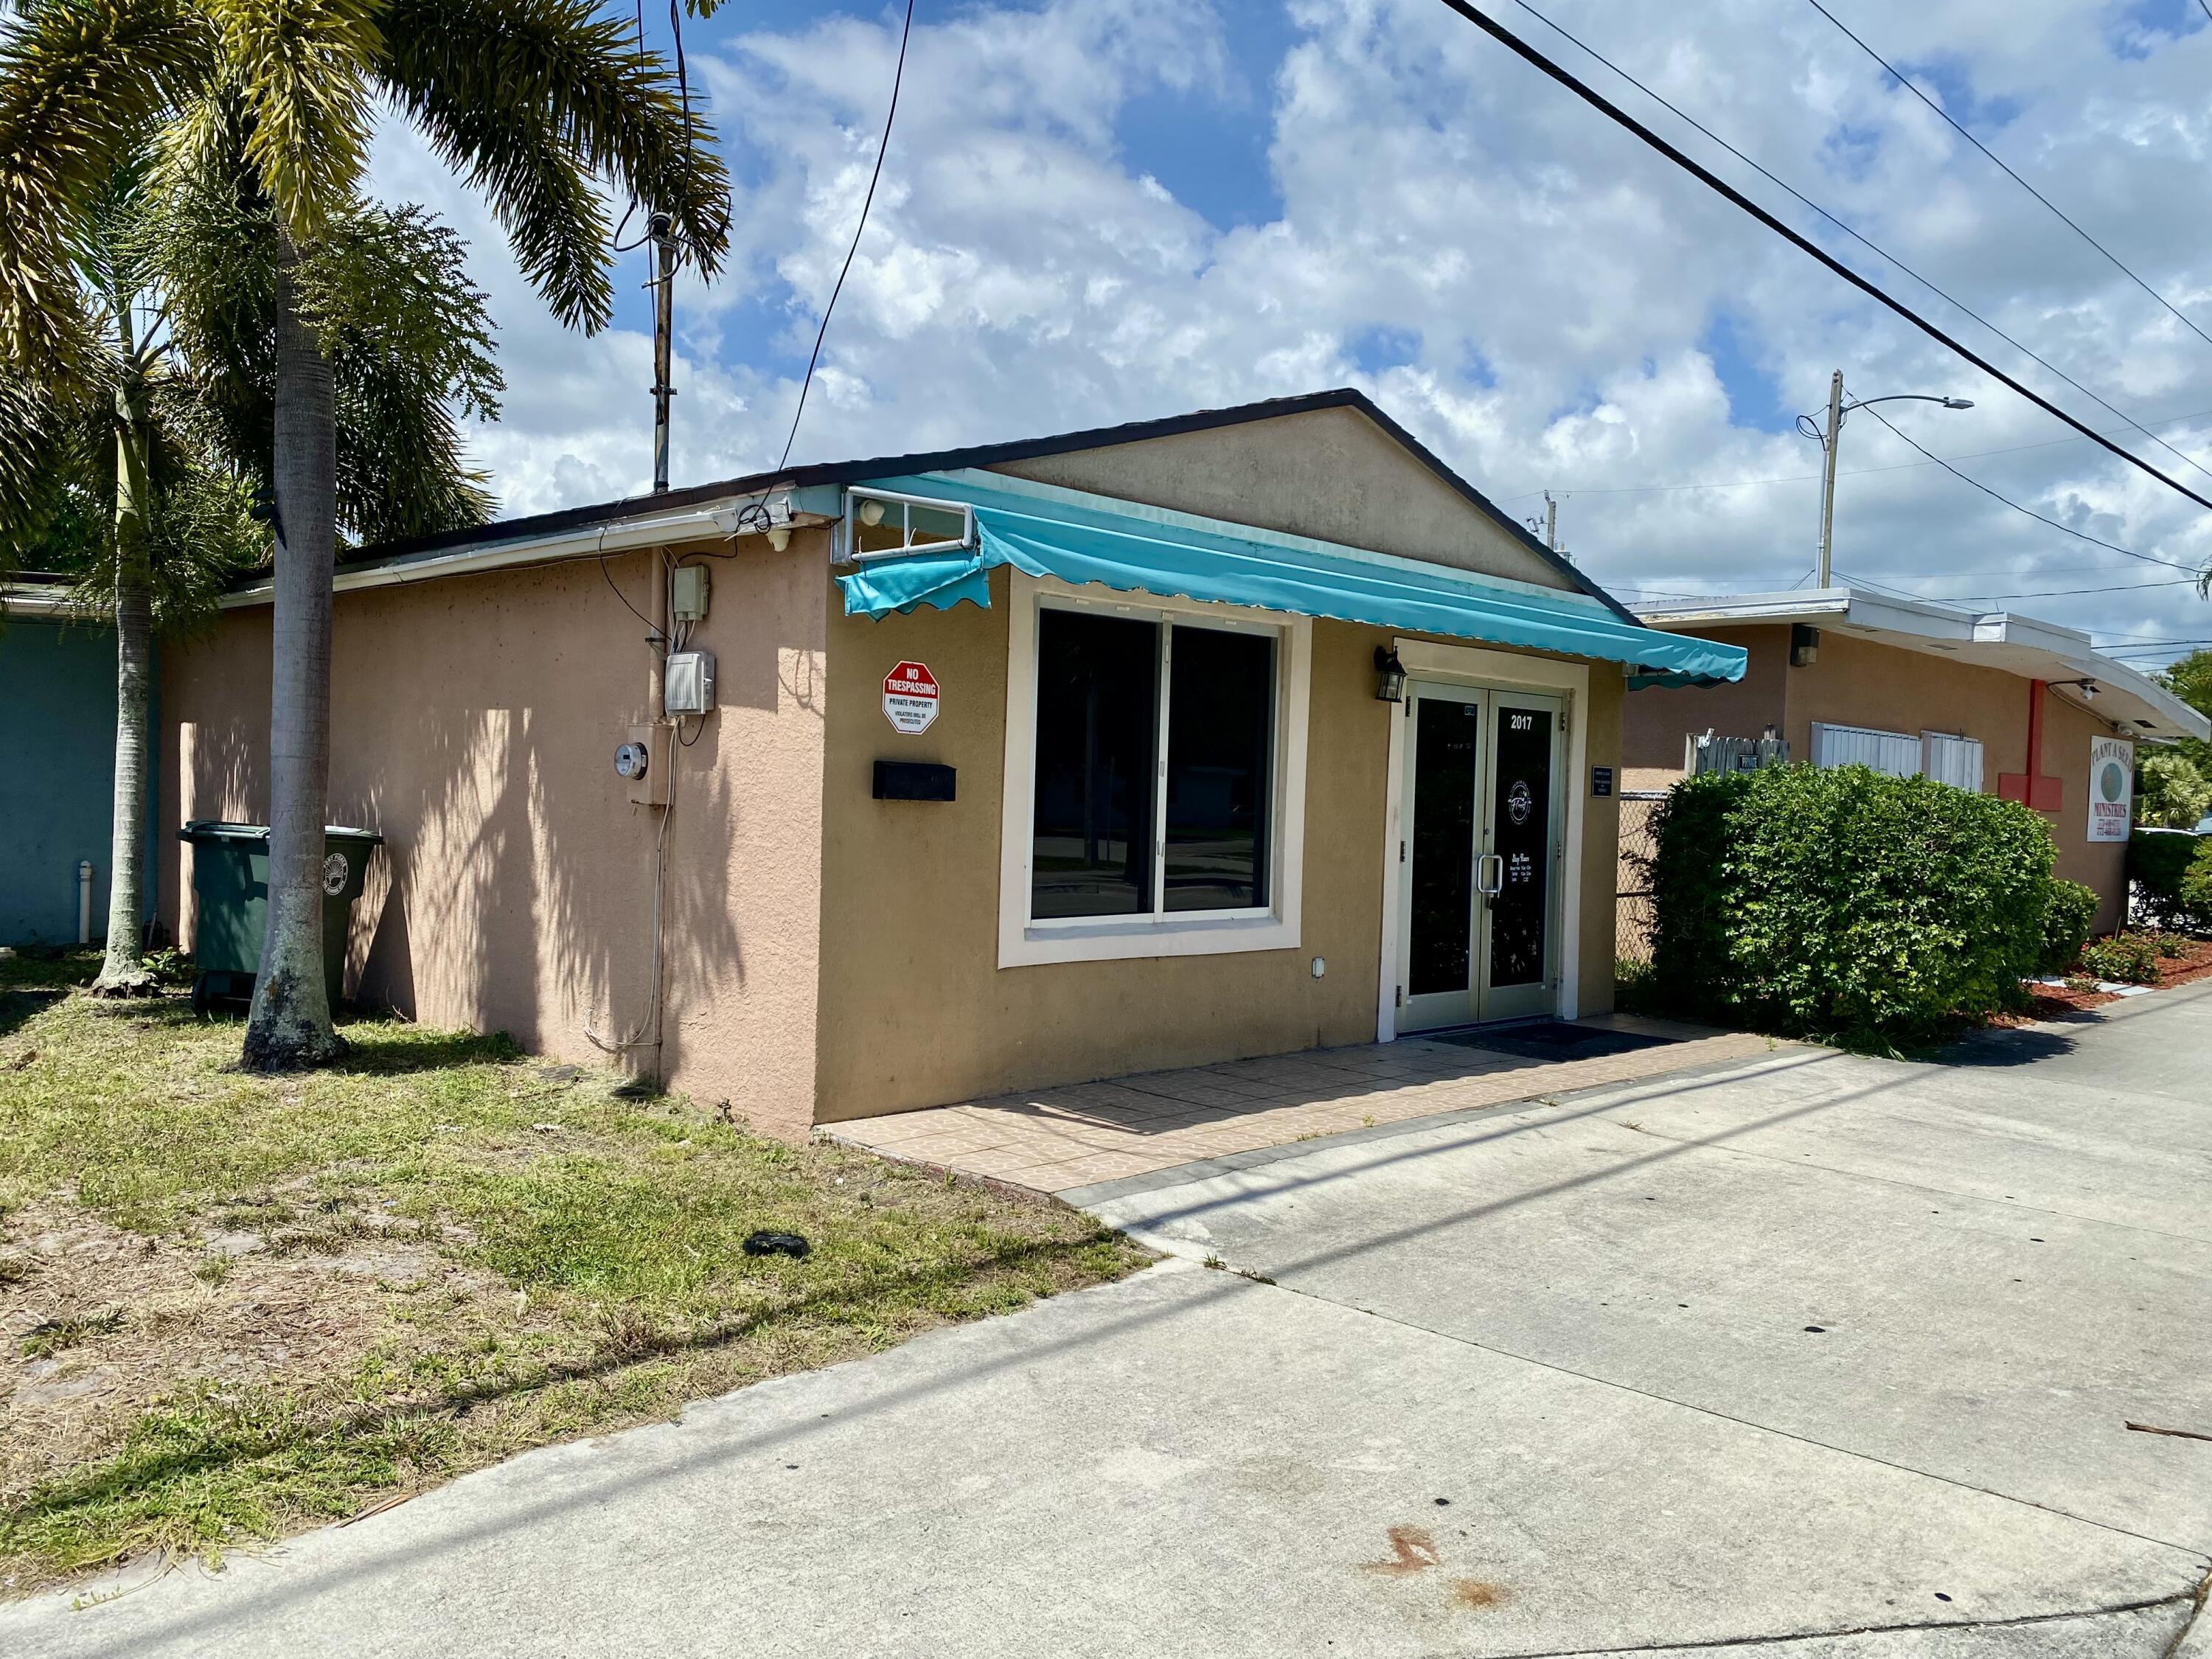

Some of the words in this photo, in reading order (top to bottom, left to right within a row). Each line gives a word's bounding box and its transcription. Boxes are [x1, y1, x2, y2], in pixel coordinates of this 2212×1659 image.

[906, 668, 919, 680] NO
[888, 679, 936, 695] TRESPASSING
[889, 698, 908, 706] PRIVATE
[909, 700, 933, 709] PROPERTY
[1511, 714, 1532, 730] 2017
[2092, 742, 2112, 767] PLANT
[2112, 743, 2117, 758] A
[2094, 802, 2126, 818] MINISTRIES
